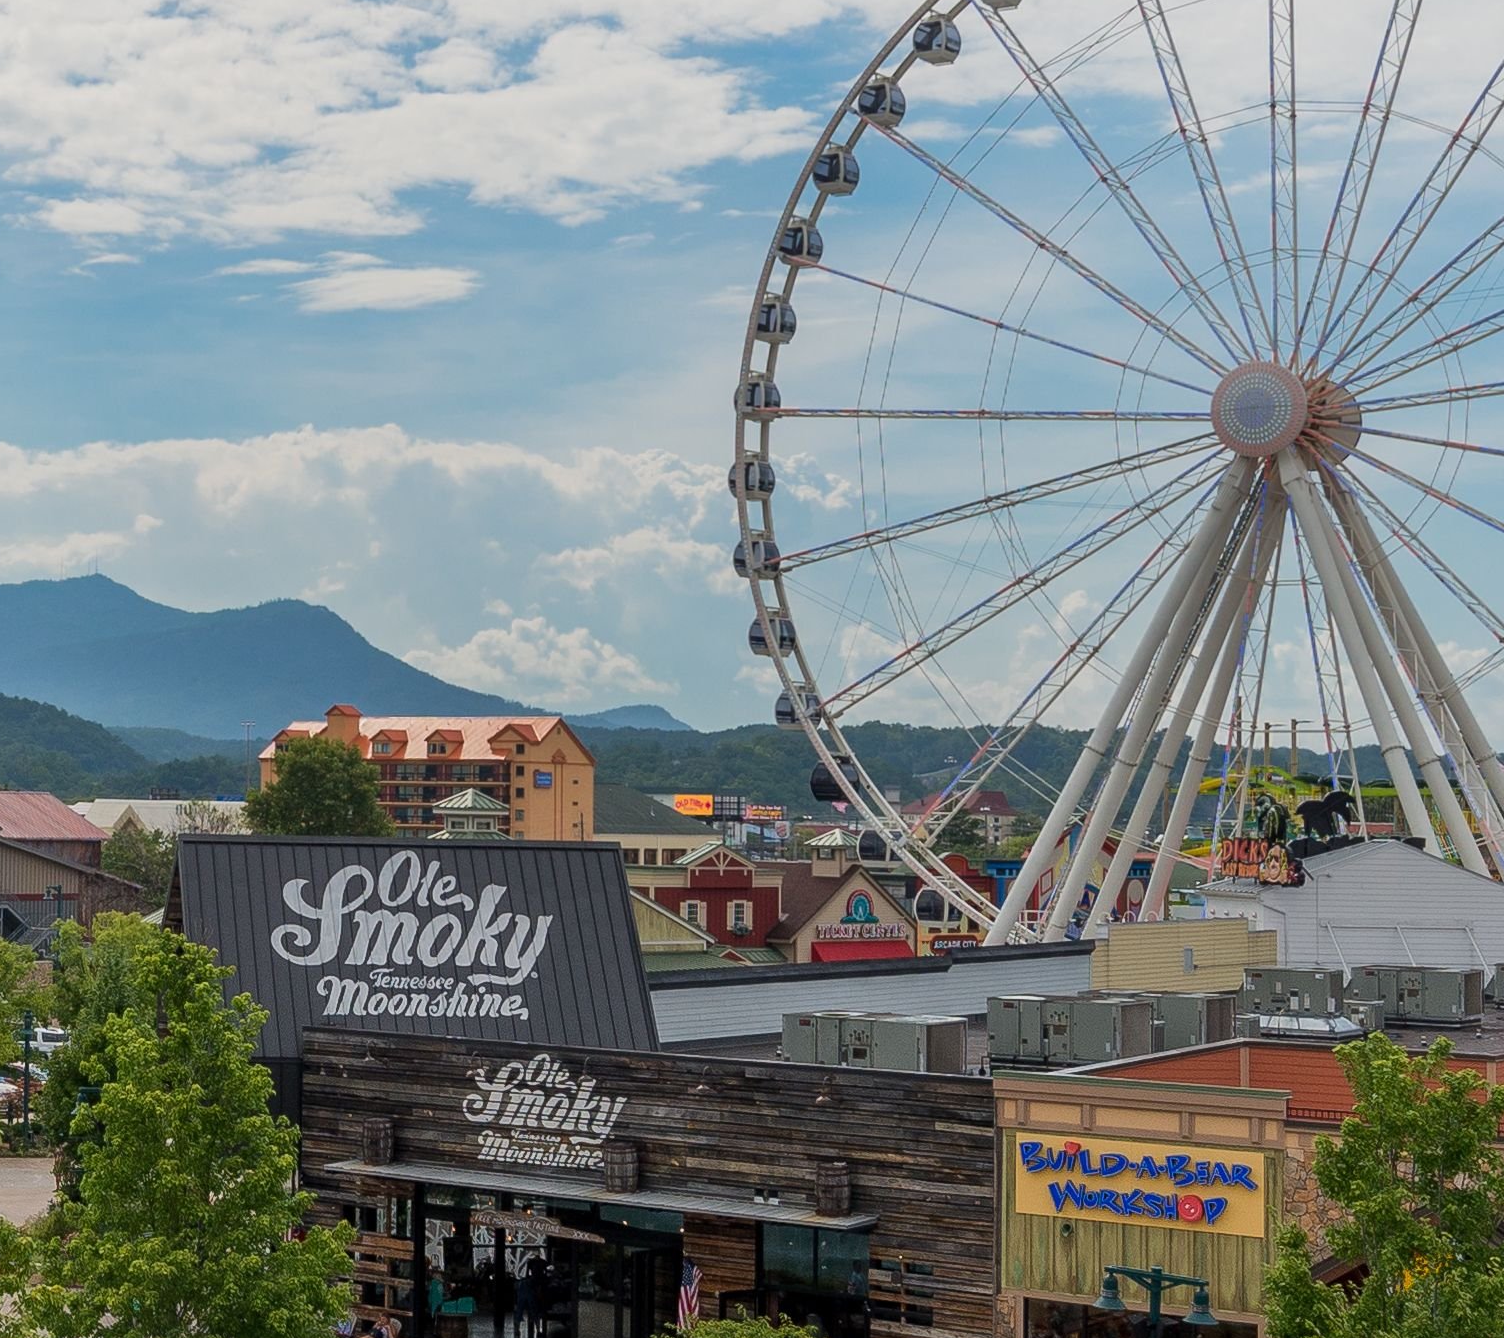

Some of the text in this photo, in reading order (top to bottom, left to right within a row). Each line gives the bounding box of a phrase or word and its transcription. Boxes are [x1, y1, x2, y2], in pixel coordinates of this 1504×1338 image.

[377, 849, 475, 913] Ole
[270, 864, 554, 986] Smoky
[816, 923, 862, 940] TICKET
[962, 940, 977, 948] CITY
[316, 975, 529, 1021] Moonshine
[369, 967, 455, 991] Tennessee
[524, 1053, 579, 1094] Ole
[462, 1061, 629, 1146] Smoky
[477, 1130, 606, 1170] Moonshine
[1047, 1180, 1229, 1225] WORKSHOP
